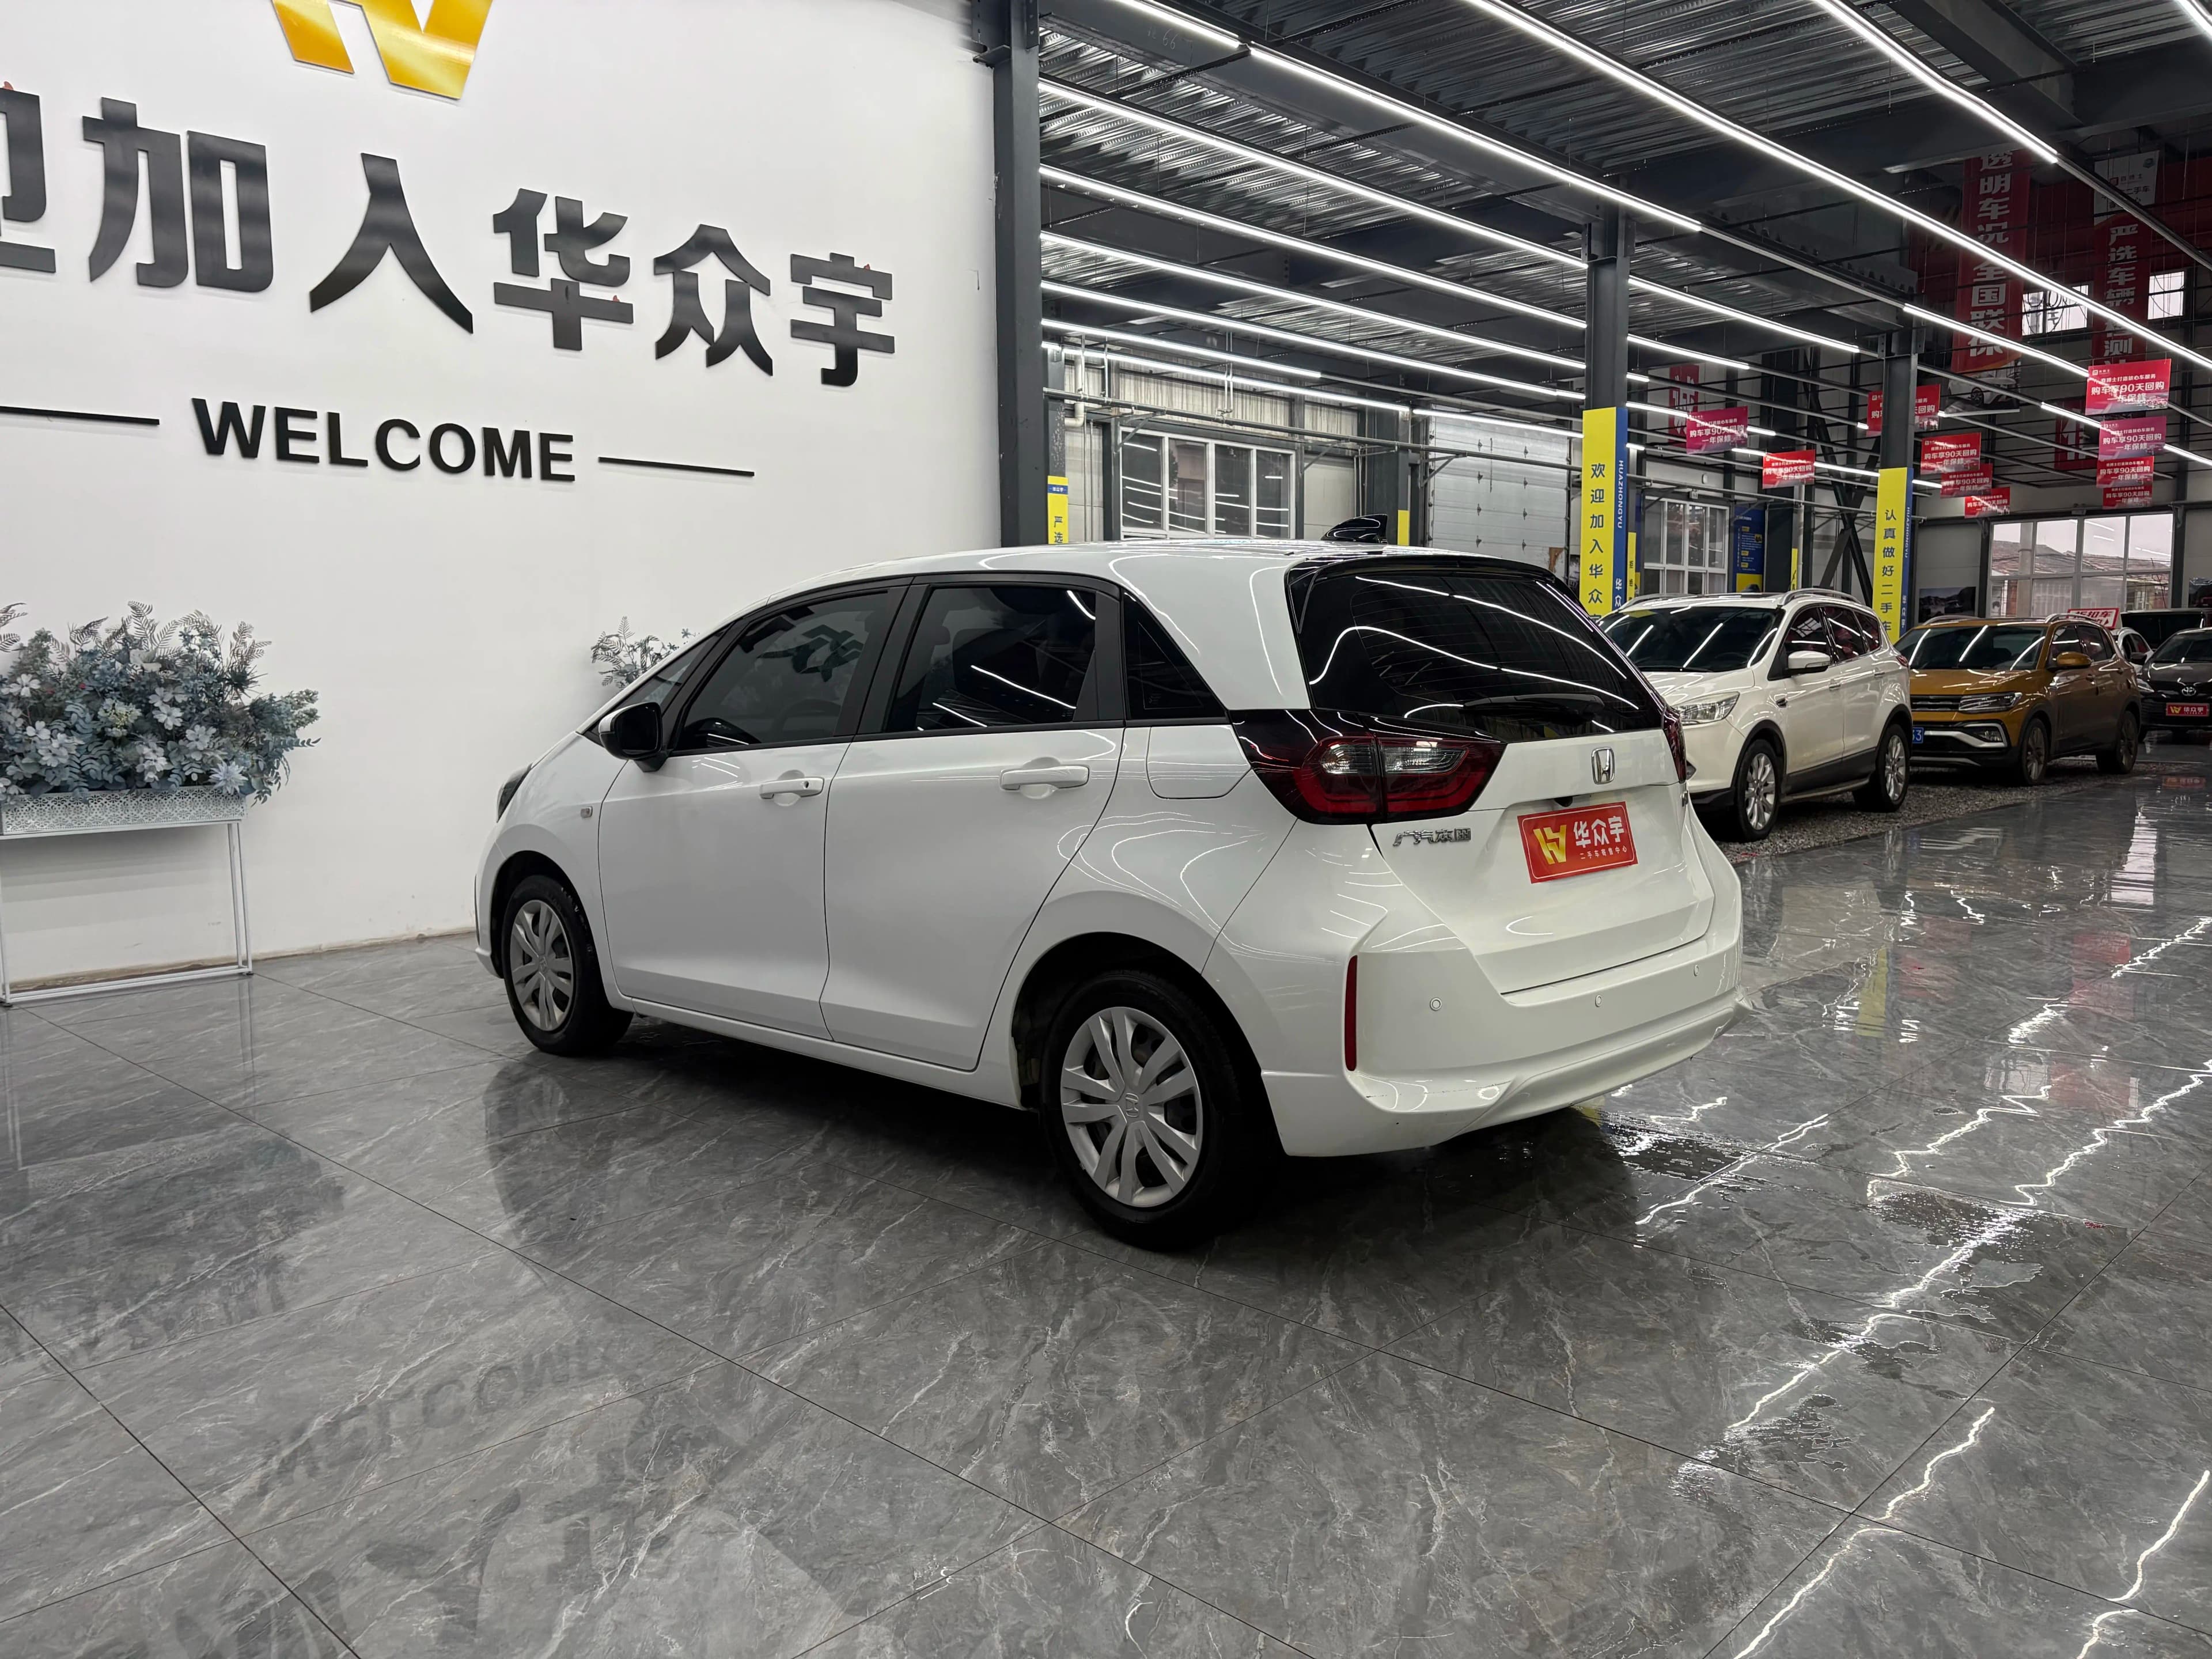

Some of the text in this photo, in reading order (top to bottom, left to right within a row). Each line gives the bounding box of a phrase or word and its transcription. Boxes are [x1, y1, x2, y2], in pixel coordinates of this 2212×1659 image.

[1977, 150, 2013, 244] 透明车况
[2105, 224, 2138, 306] 严选车辆
[191, 397, 575, 482] WELCOME
[2103, 433, 2162, 445] 购车享90天回购
[2116, 442, 2147, 451] 一年保修
[1924, 449, 1977, 460] 购车享90天回购
[2100, 466, 2150, 475] 购车享90天回购
[1054, 516, 1063, 544] 严选
[1880, 509, 1896, 631] 认真做好二手车
[1573, 816, 1624, 849] 华众宇
[1579, 845, 1627, 859] 二手车寄售中心
